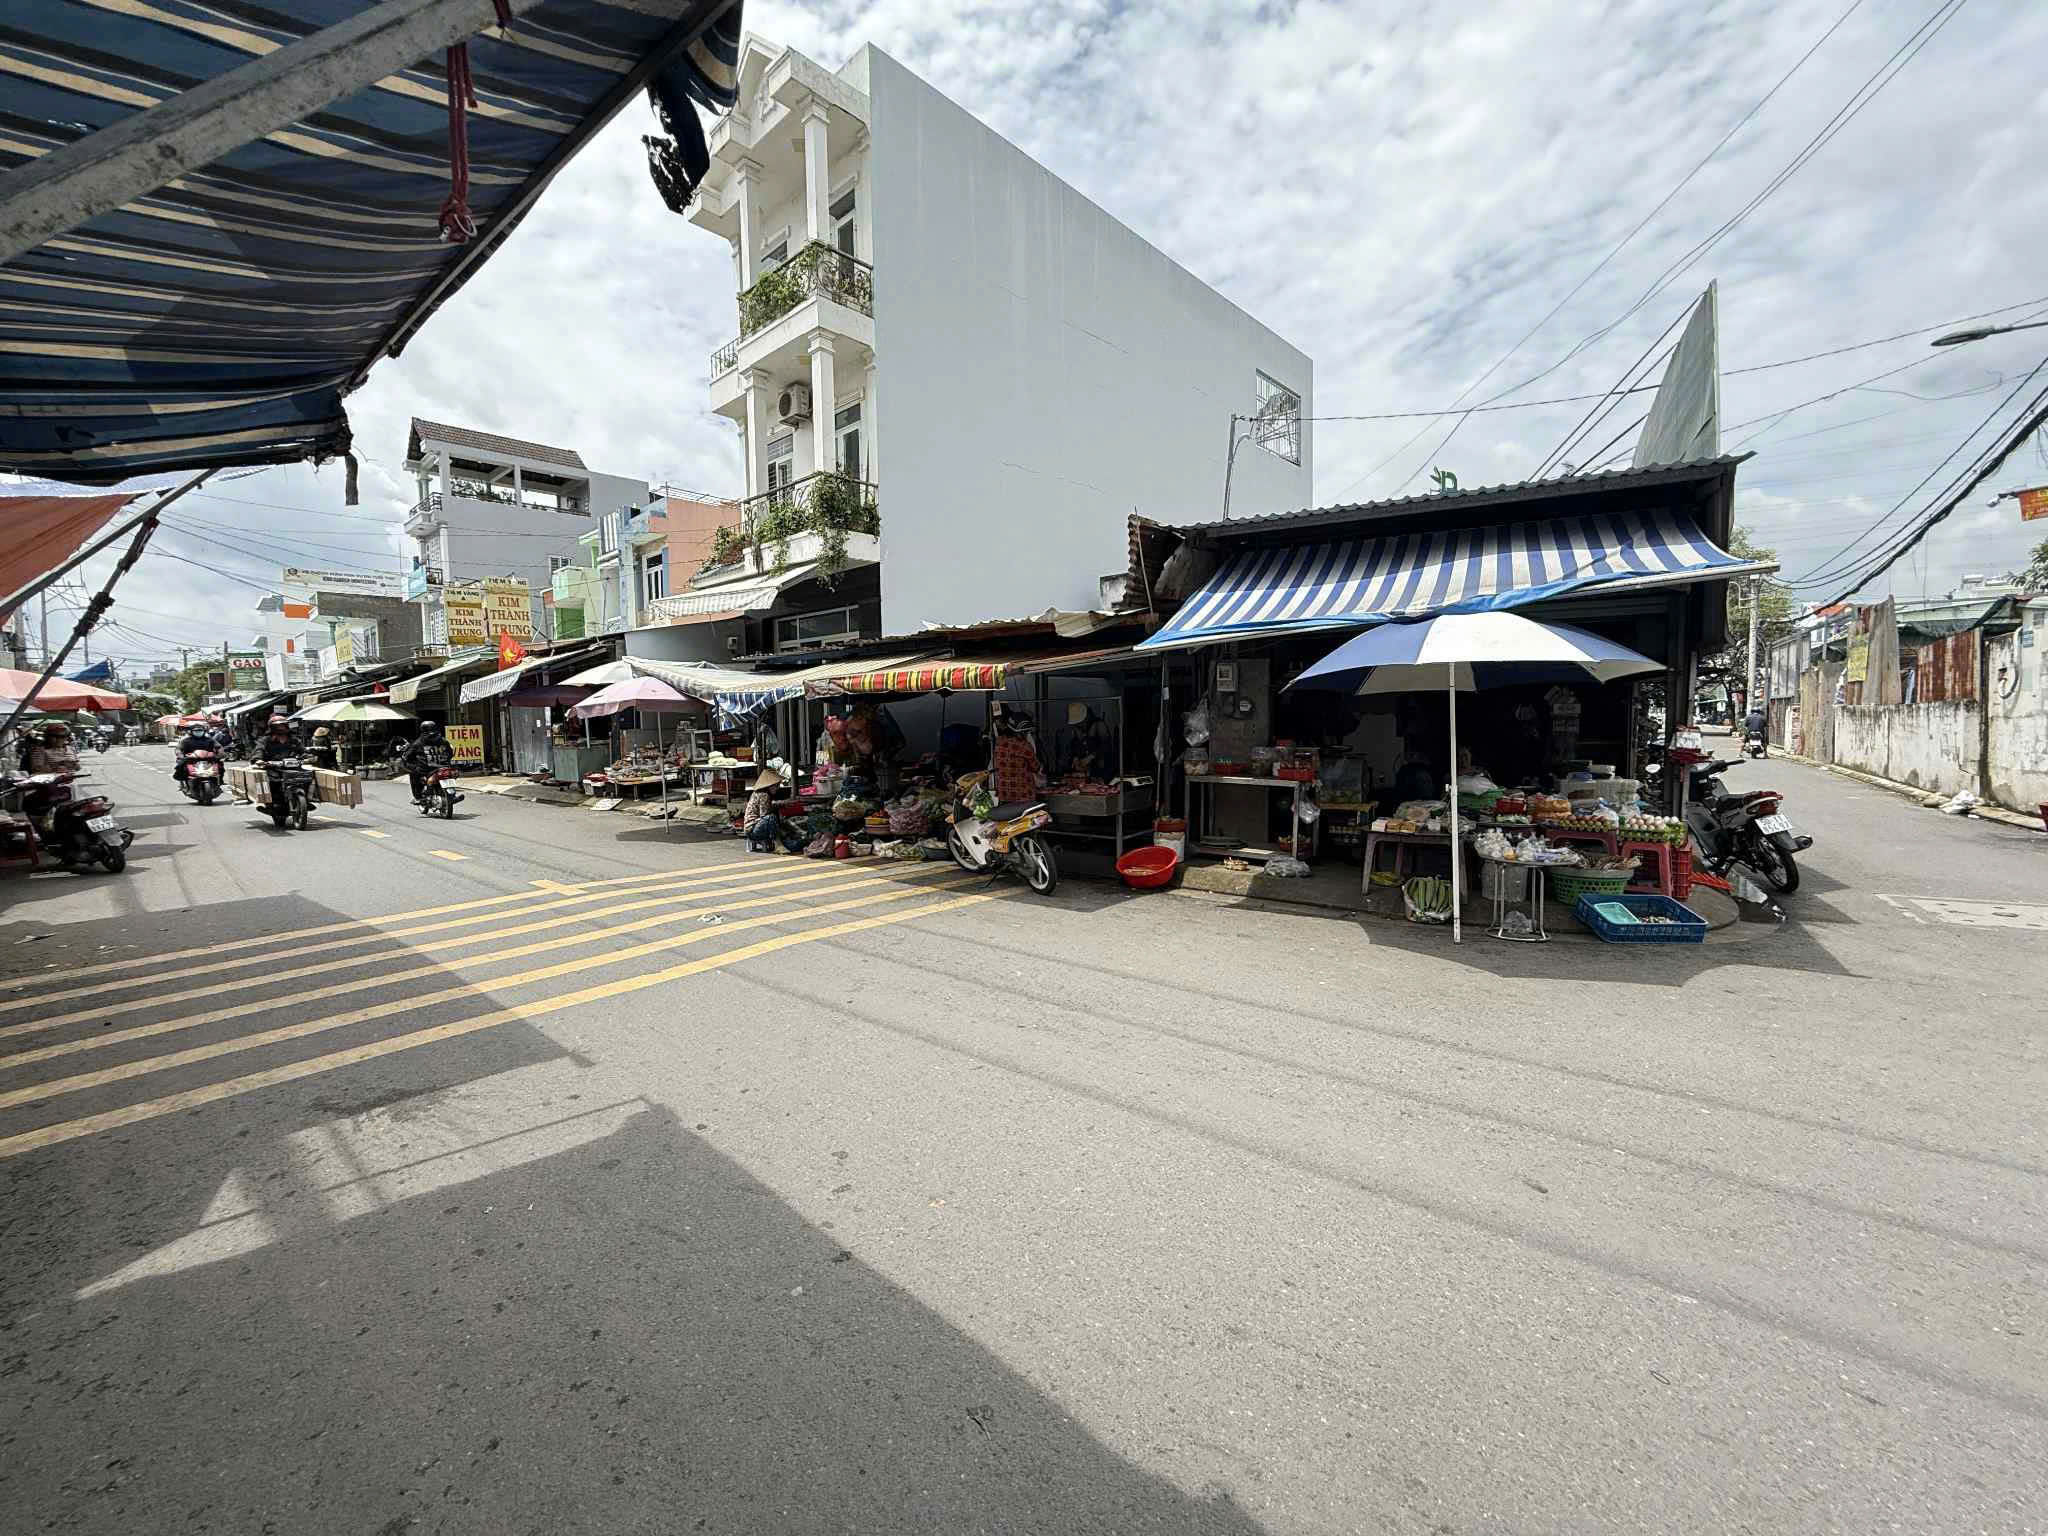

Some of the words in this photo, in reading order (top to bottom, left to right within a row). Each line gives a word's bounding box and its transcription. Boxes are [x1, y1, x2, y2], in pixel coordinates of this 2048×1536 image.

[498, 597, 520, 607] KIM
[455, 608, 474, 616] KIM
[490, 608, 529, 620] THÀNH
[449, 616, 482, 626] THÀNH
[450, 628, 482, 636] TRUNG
[492, 623, 531, 634] TRUNG
[448, 726, 480, 742] TIỆM
